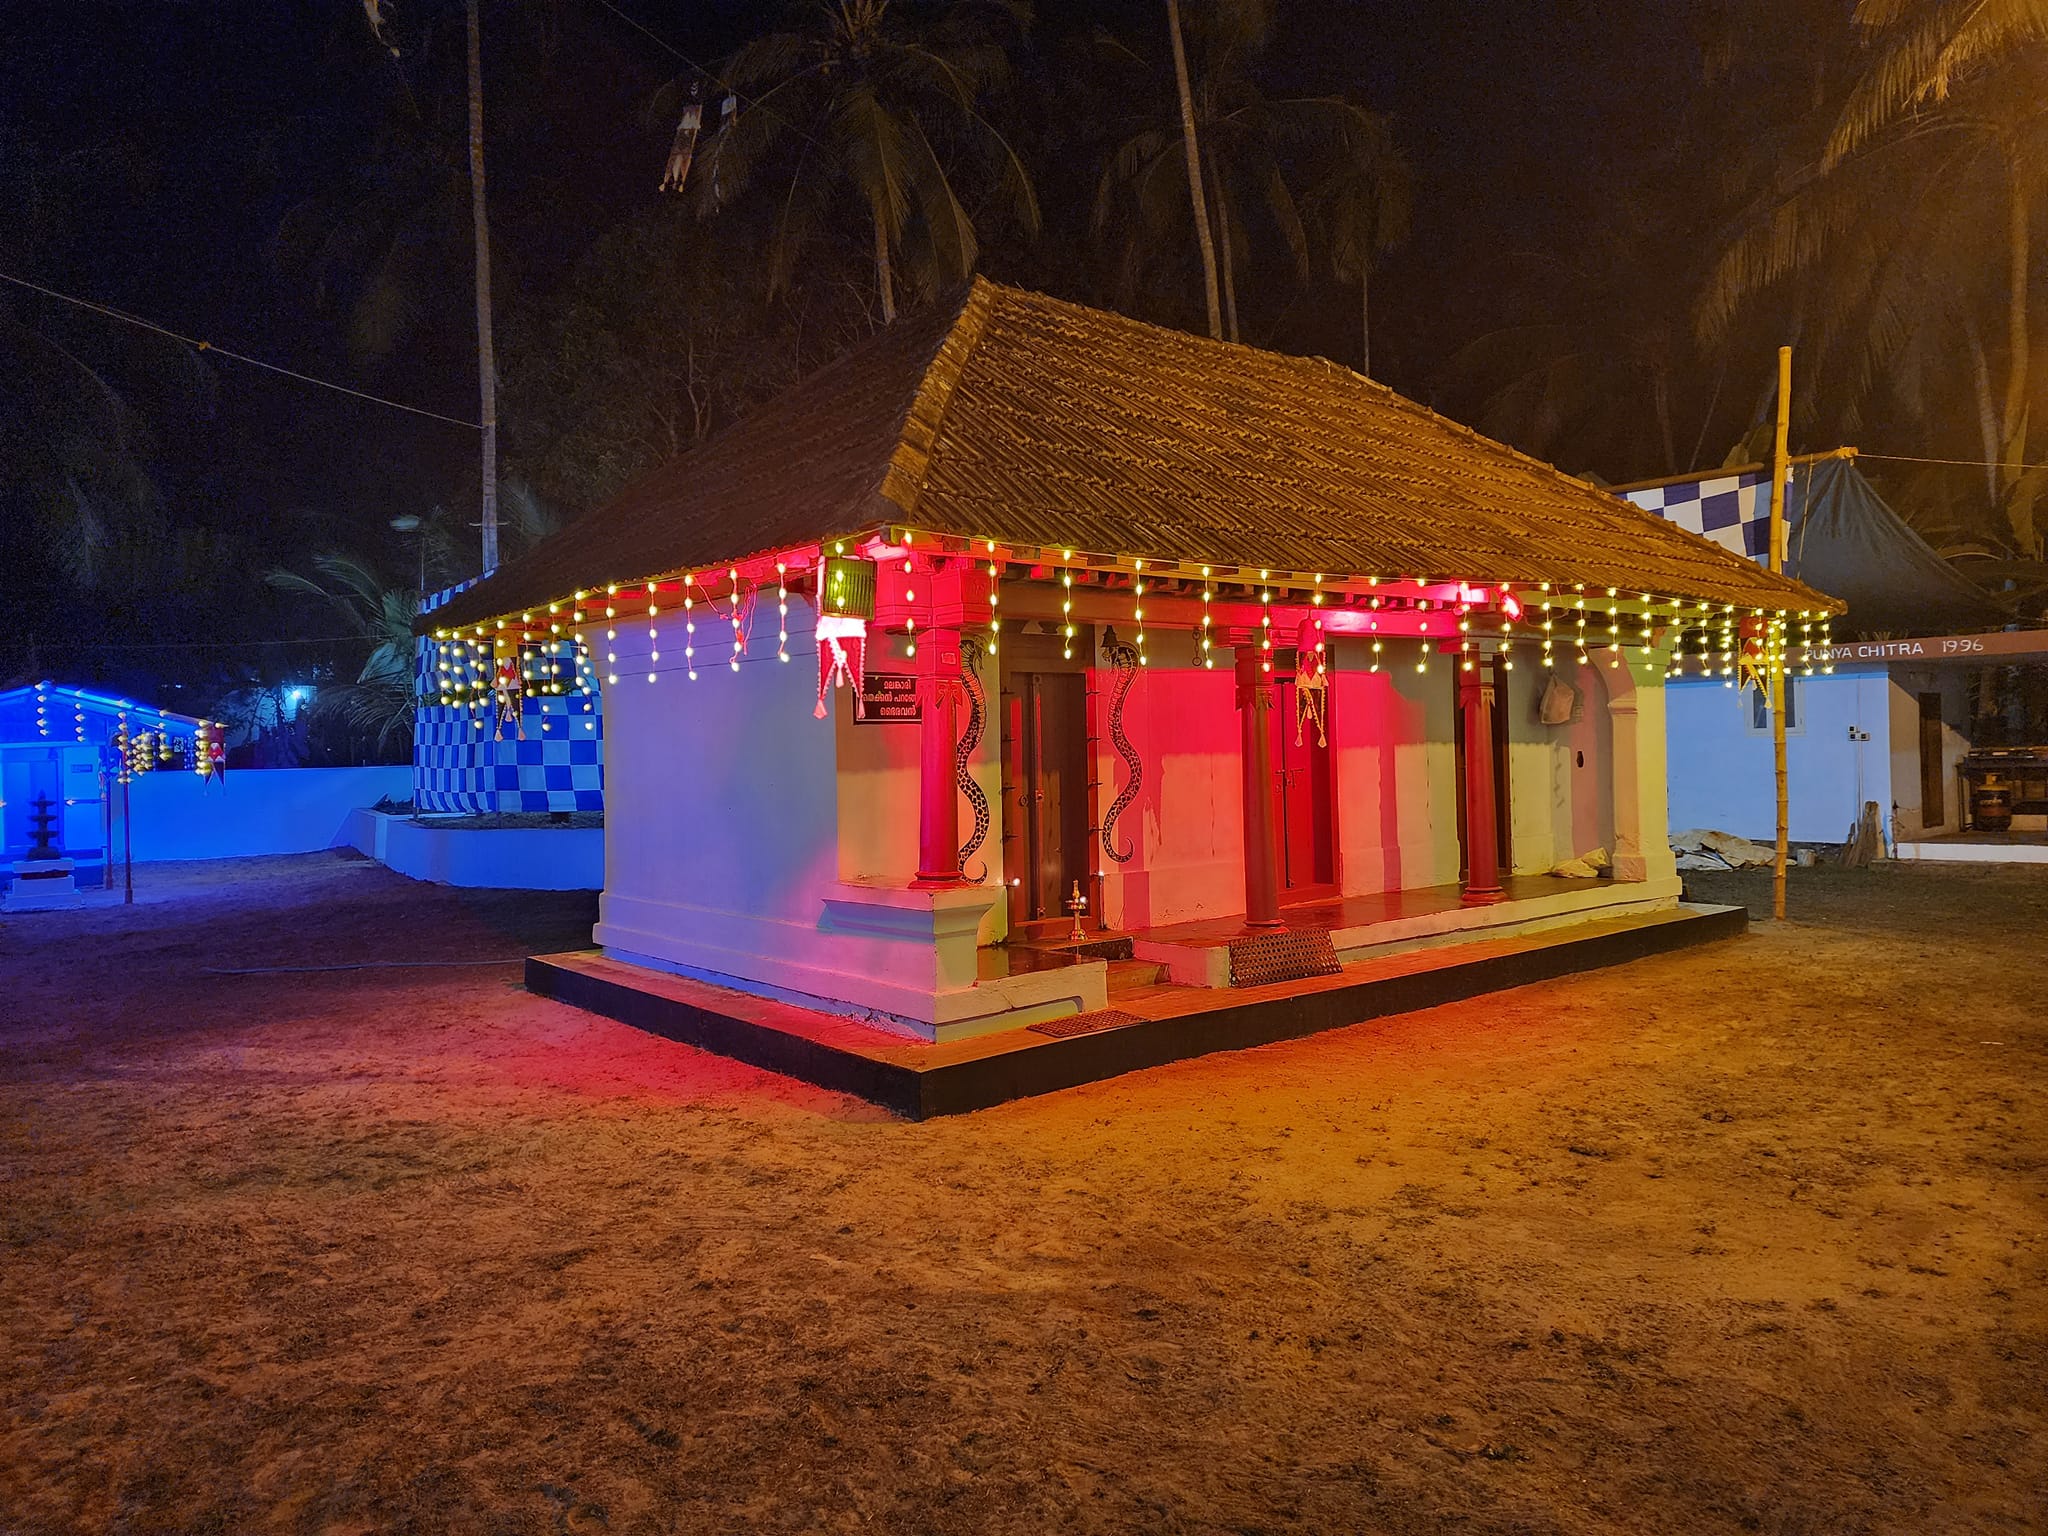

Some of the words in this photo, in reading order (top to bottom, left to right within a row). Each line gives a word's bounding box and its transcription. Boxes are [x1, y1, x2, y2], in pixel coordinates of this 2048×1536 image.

[1805, 647, 1853, 660] PUNYA
[1858, 643, 1924, 658] CHITRA
[1942, 639, 1984, 653] 1996
